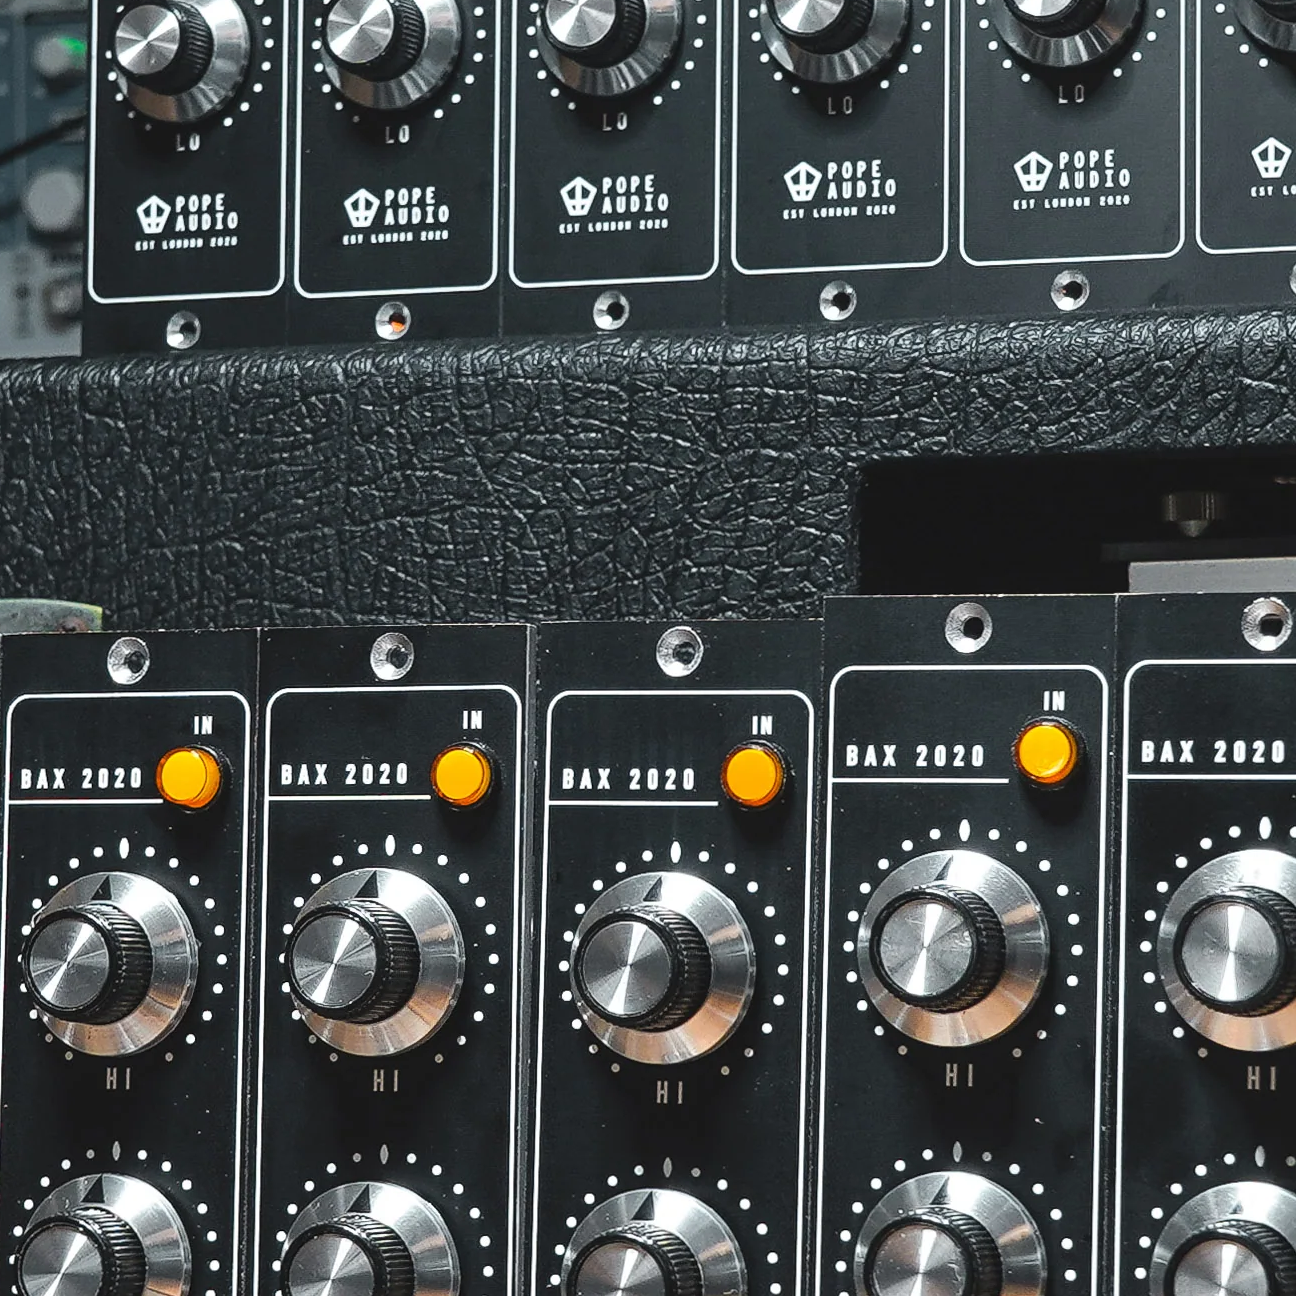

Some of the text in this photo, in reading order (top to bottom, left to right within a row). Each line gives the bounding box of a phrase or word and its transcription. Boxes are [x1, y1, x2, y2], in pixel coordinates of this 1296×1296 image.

[827, 95, 853, 115] LO
[1057, 84, 1085, 105] LO
[602, 112, 628, 132] LO
[176, 132, 201, 152] LO
[385, 124, 410, 144] LO
[827, 159, 882, 180] POPE
[1059, 148, 1115, 170] POPE
[602, 174, 655, 195] POPE
[827, 178, 897, 200] AUDIO
[1058, 168, 1131, 190] AUDIO
[175, 192, 225, 213] POPE
[384, 186, 436, 207] POPE
[601, 193, 669, 215] AUDIO
[174, 211, 239, 232] AUDIO
[384, 204, 450, 226] AUDIO
[1043, 690, 1066, 712] IN
[193, 715, 213, 735] IN
[462, 710, 483, 730] IN
[751, 715, 773, 736] IN
[846, 744, 984, 767] BAX 2020
[1141, 739, 1285, 764] BAX 2020
[20, 766, 142, 790] BAX 2020
[281, 762, 408, 786] BAX 2020
[562, 767, 695, 791] BAX 2020
[106, 1067, 131, 1090] HI
[372, 1069, 399, 1092] HI
[945, 1062, 973, 1087] HI
[1247, 1065, 1276, 1091] HI
[656, 1080, 683, 1105] HI
